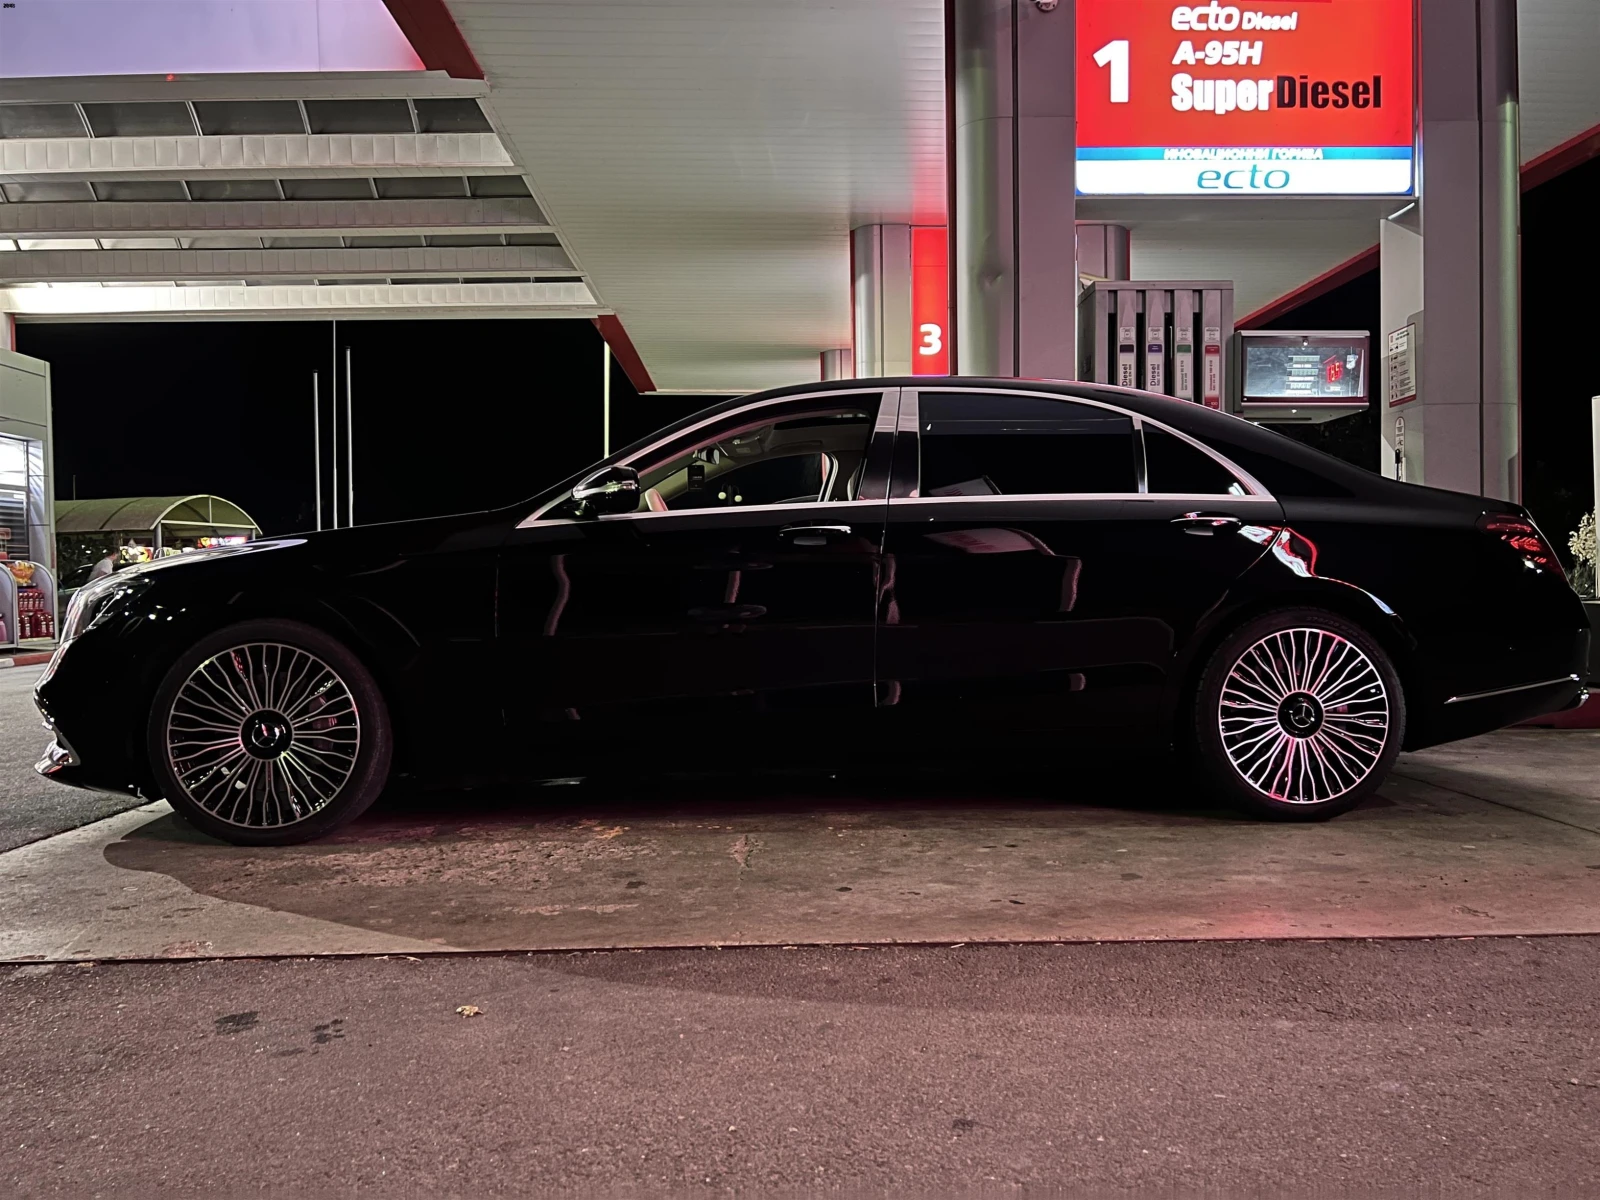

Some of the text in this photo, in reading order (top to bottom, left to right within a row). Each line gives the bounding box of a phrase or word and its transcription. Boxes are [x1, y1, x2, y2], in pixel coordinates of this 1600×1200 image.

[1172, 1, 1298, 31] ecto Diesel
[1093, 40, 1130, 103] 1
[1197, 164, 1291, 190] ecto
[919, 323, 942, 356] 3
